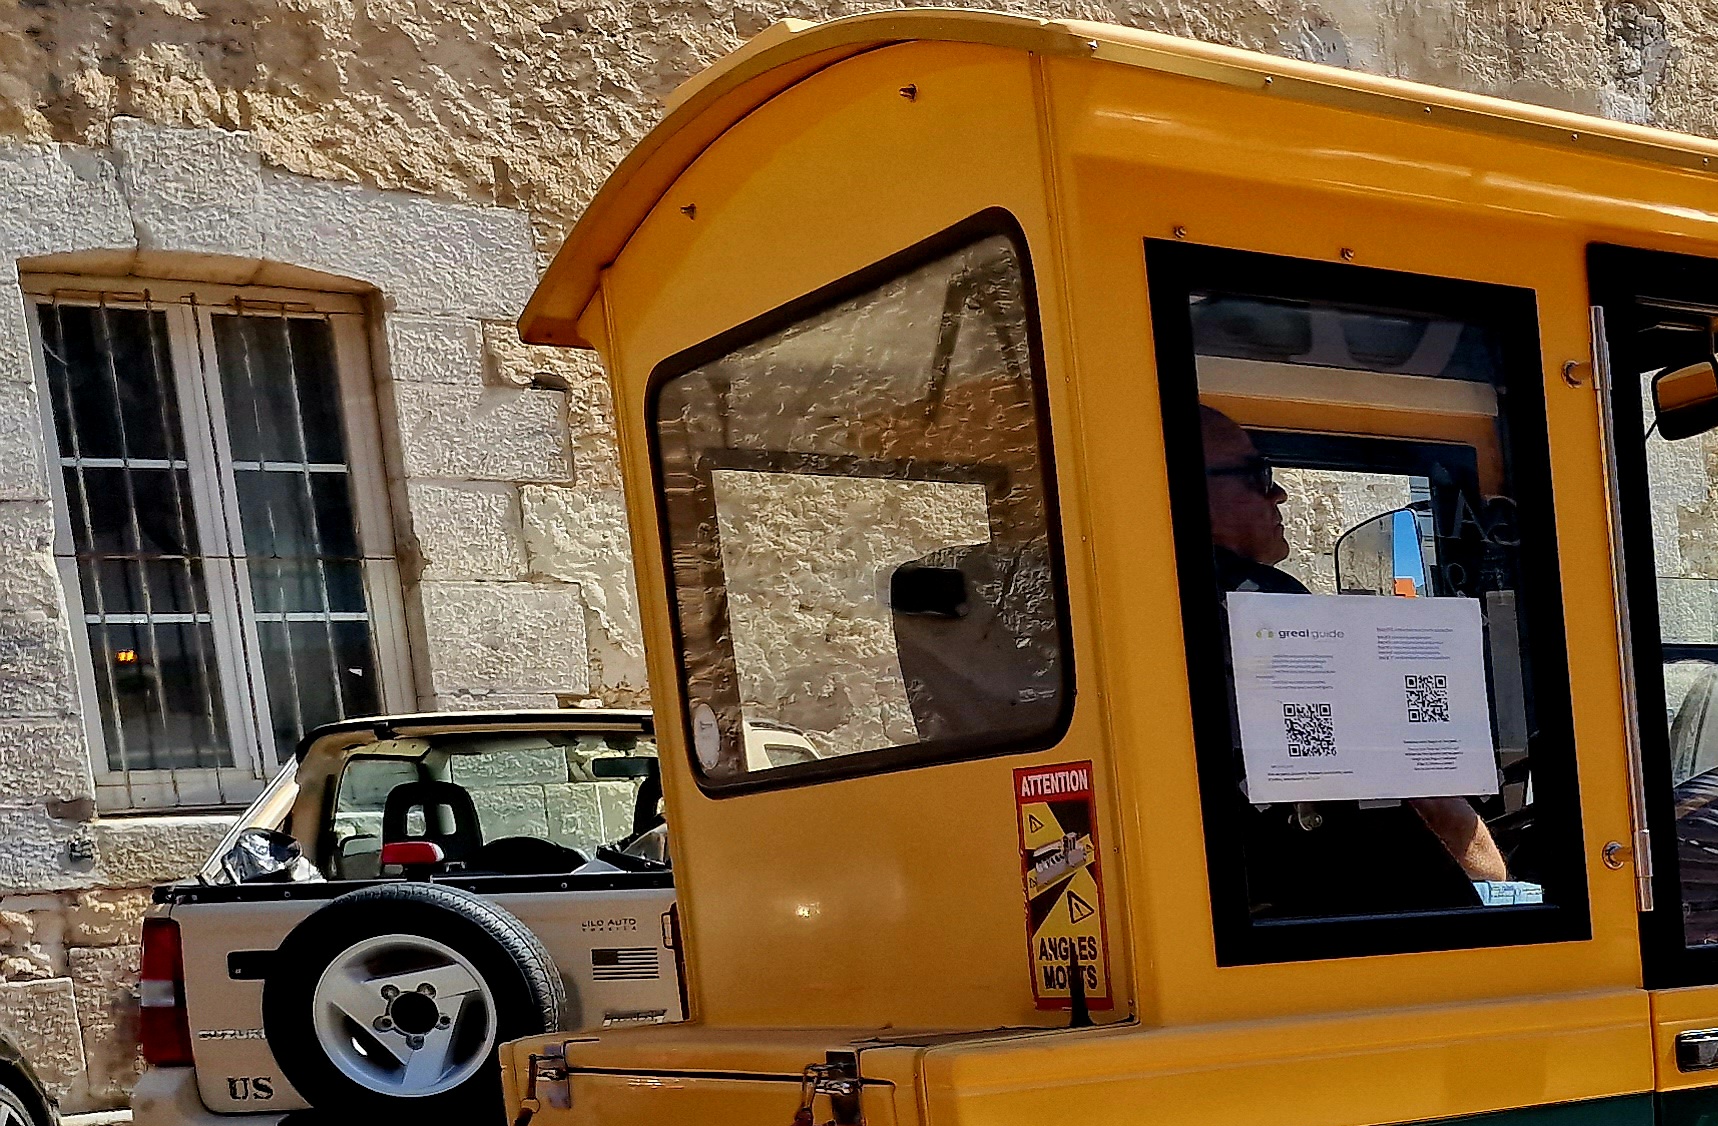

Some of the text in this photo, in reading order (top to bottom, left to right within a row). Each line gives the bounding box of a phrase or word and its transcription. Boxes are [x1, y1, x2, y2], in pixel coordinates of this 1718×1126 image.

[1021, 769, 1089, 797] ATTENTION
[607, 917, 637, 927] AUTO
[1038, 935, 1098, 961] ANGES
[226, 1076, 274, 1100] US
